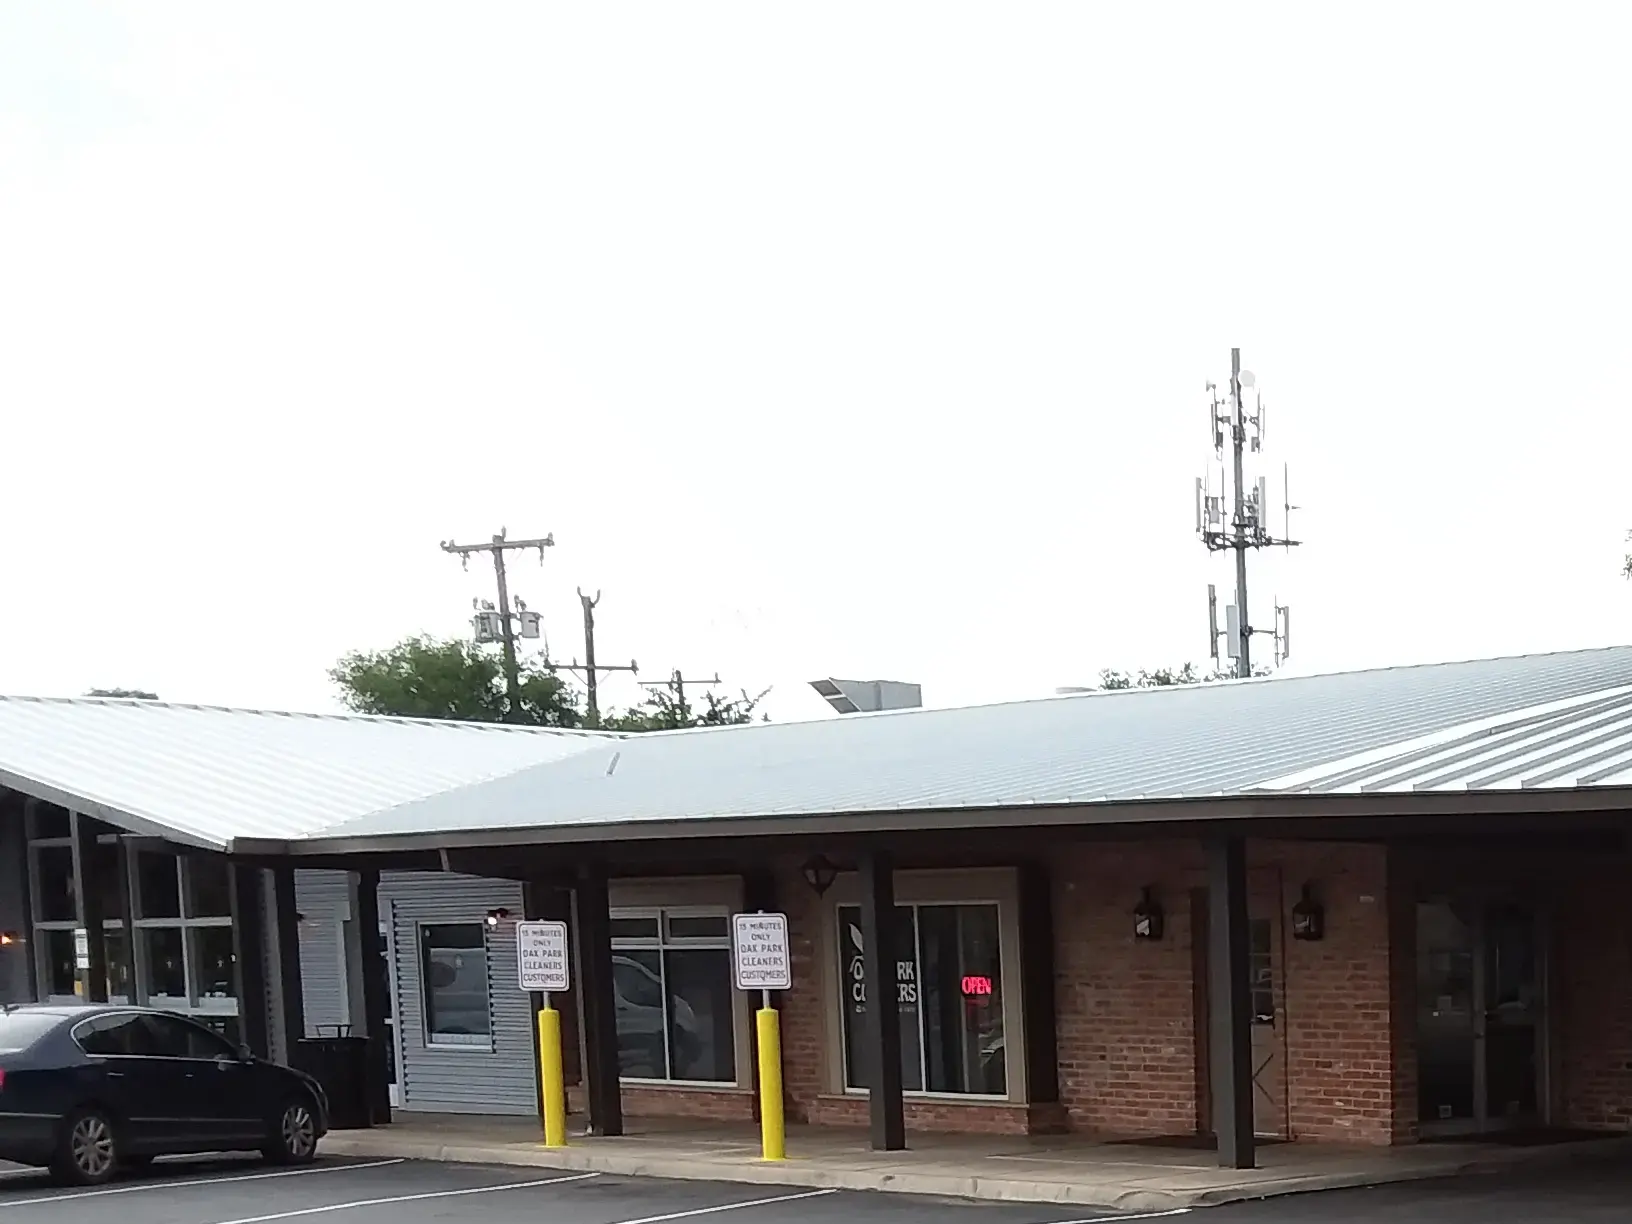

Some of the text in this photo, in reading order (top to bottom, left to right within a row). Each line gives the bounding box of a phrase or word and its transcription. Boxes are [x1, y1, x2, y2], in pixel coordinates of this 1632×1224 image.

[751, 933, 770, 941] ONLY
[533, 939, 551, 947] ONLY
[740, 943, 783, 953] OAK PARK
[542, 949, 563, 958] PARK
[524, 961, 562, 970] CLEANERS
[742, 957, 783, 966] CLEANERS
[523, 973, 565, 982] CUSTOMERS
[741, 970, 786, 979] CUSTOMERS
[961, 976, 992, 995] OPEN
